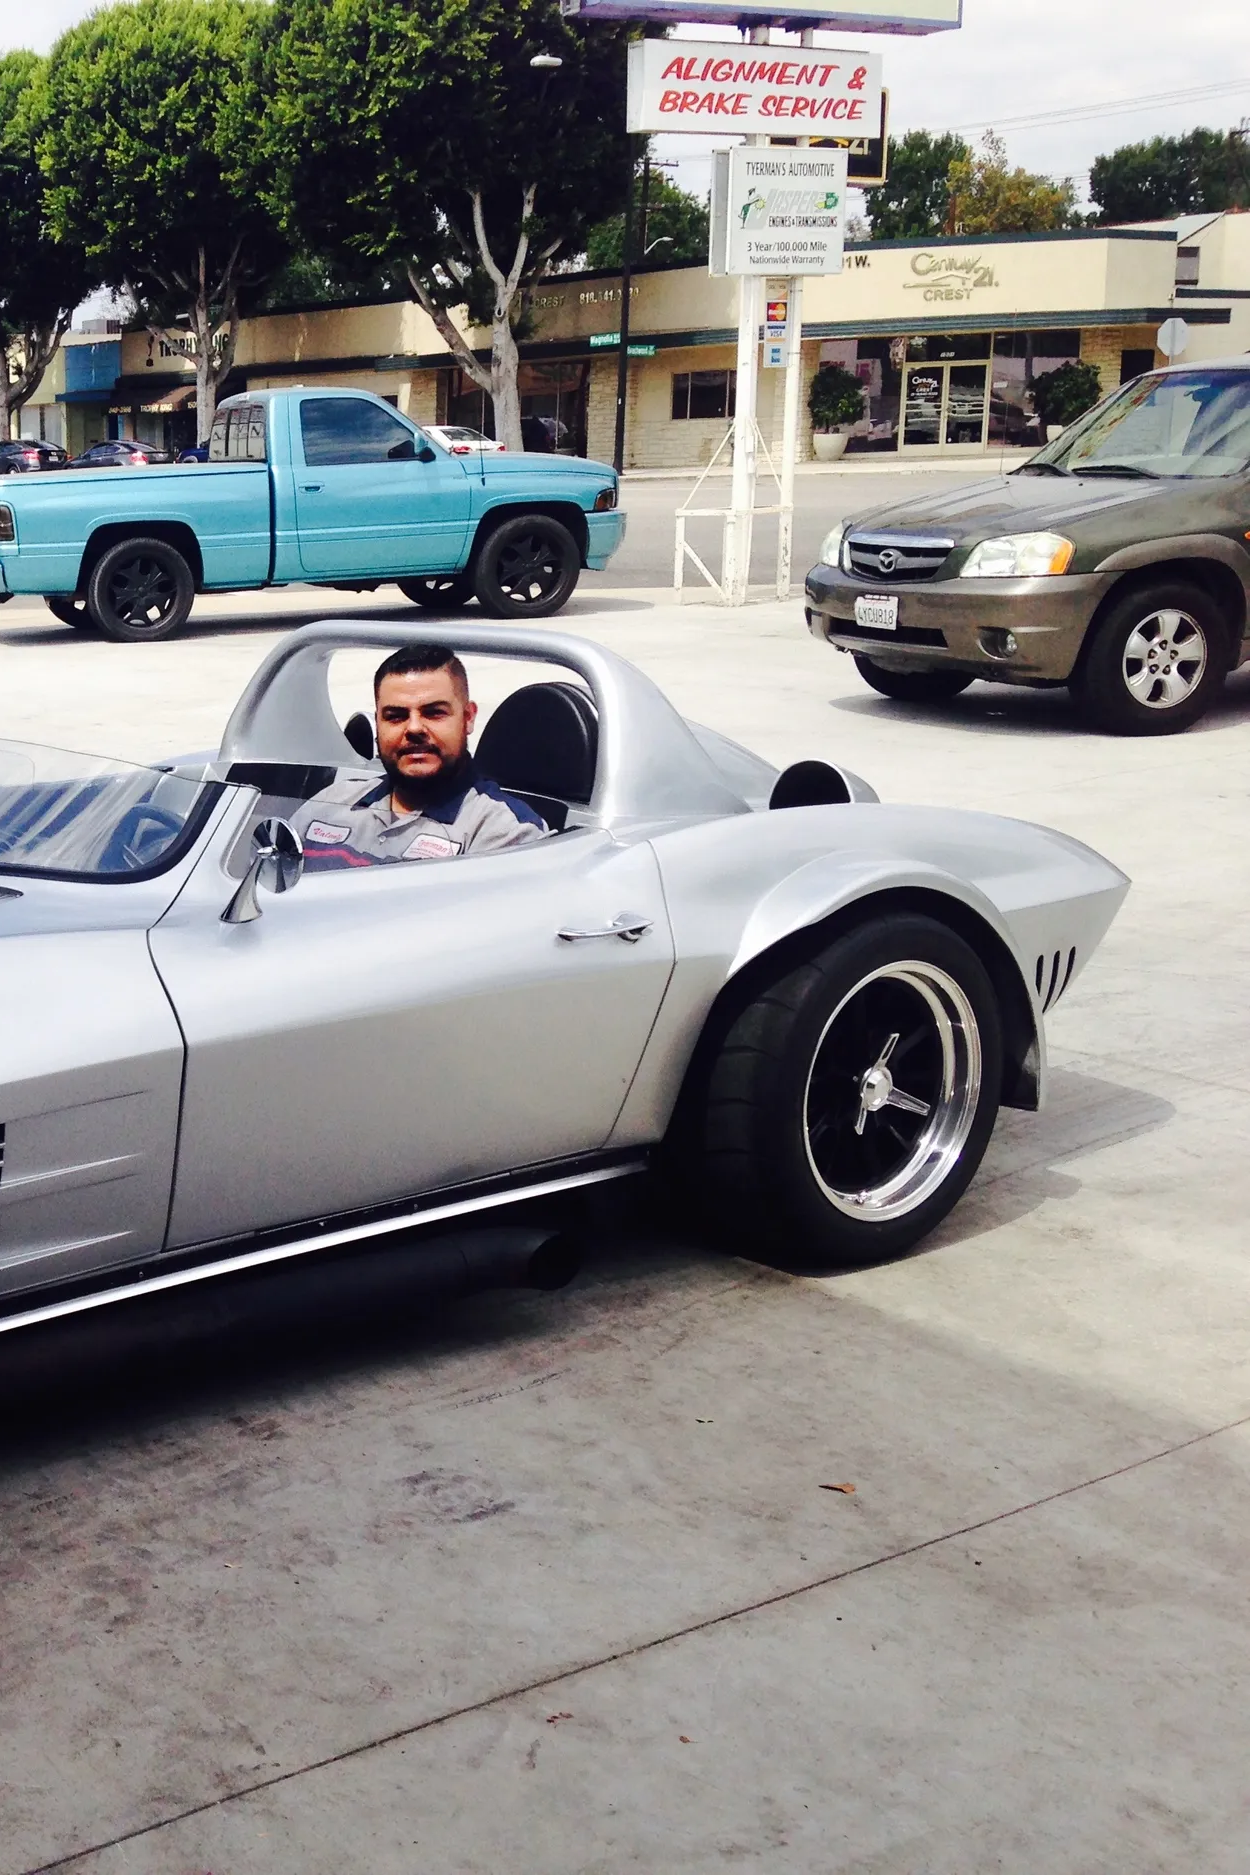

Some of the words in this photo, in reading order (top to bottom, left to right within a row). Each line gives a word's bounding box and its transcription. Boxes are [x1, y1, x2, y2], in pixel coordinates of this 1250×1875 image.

[661, 56, 839, 87] ALIGNMENT
[847, 66, 867, 90] &
[658, 90, 752, 115] BRAKE
[758, 94, 866, 120] SERVICE
[746, 162, 786, 177] TYERMAN'S
[788, 163, 835, 178] AUTOMOTIVE
[745, 188, 819, 230] JASPER
[768, 216, 791, 228] ENGINES
[795, 216, 838, 228] TRANSMISSIONS
[747, 241, 752, 251] 3
[810, 242, 827, 252] Mile
[749, 255, 791, 265] Nationwide
[791, 256, 825, 267] Warranty
[910, 252, 981, 276] Century
[923, 288, 975, 302] CREST
